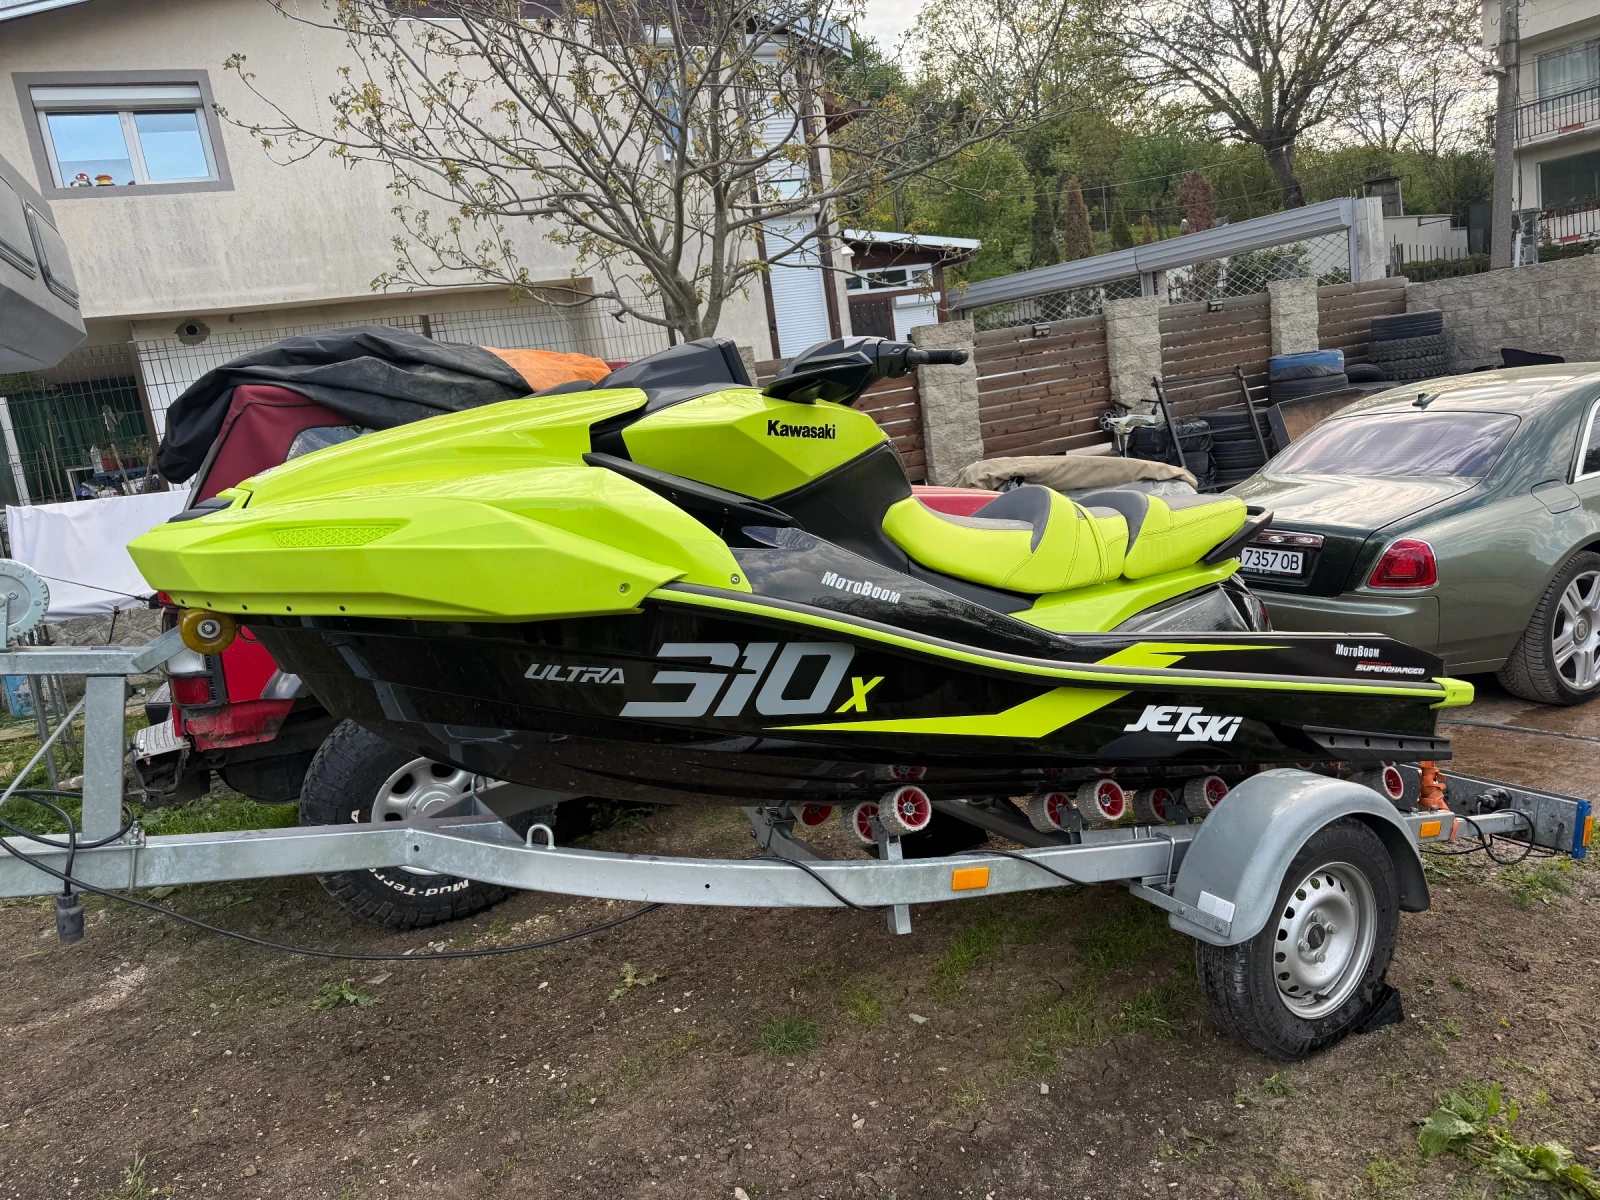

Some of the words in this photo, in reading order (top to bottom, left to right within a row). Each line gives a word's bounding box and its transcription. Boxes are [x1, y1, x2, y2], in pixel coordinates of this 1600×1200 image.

[767, 419, 836, 439] Kawasaki
[1244, 549, 1279, 568] 7357
[524, 663, 625, 684] ULTRA
[1354, 664, 1426, 676] SUPERCHARGED
